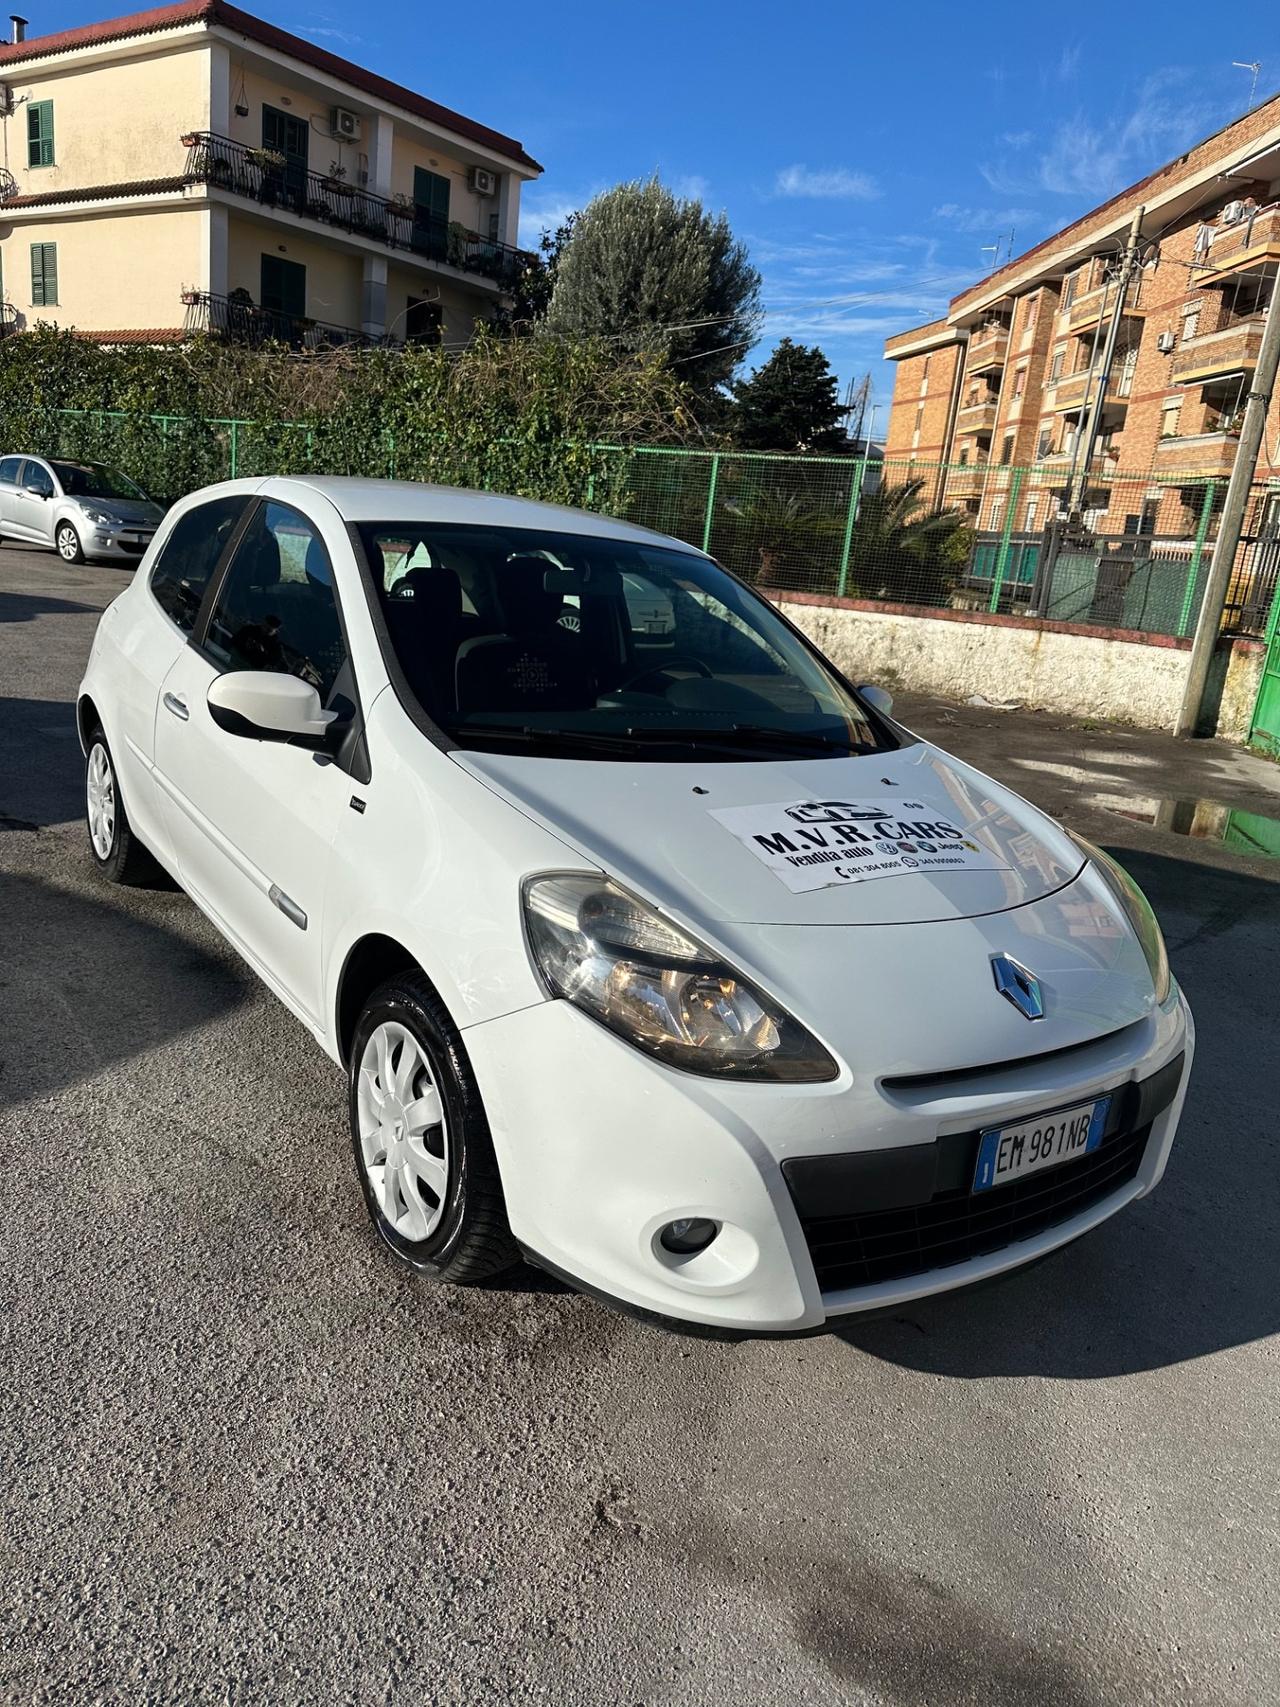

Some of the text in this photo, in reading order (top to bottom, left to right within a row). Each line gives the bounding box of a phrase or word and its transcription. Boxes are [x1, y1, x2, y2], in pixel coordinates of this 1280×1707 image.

[752, 821, 963, 856] M.V.R.CARS
[937, 842, 965, 851] Jeep
[784, 846, 874, 868] Vendita auto
[996, 1134, 1026, 1174] EM
